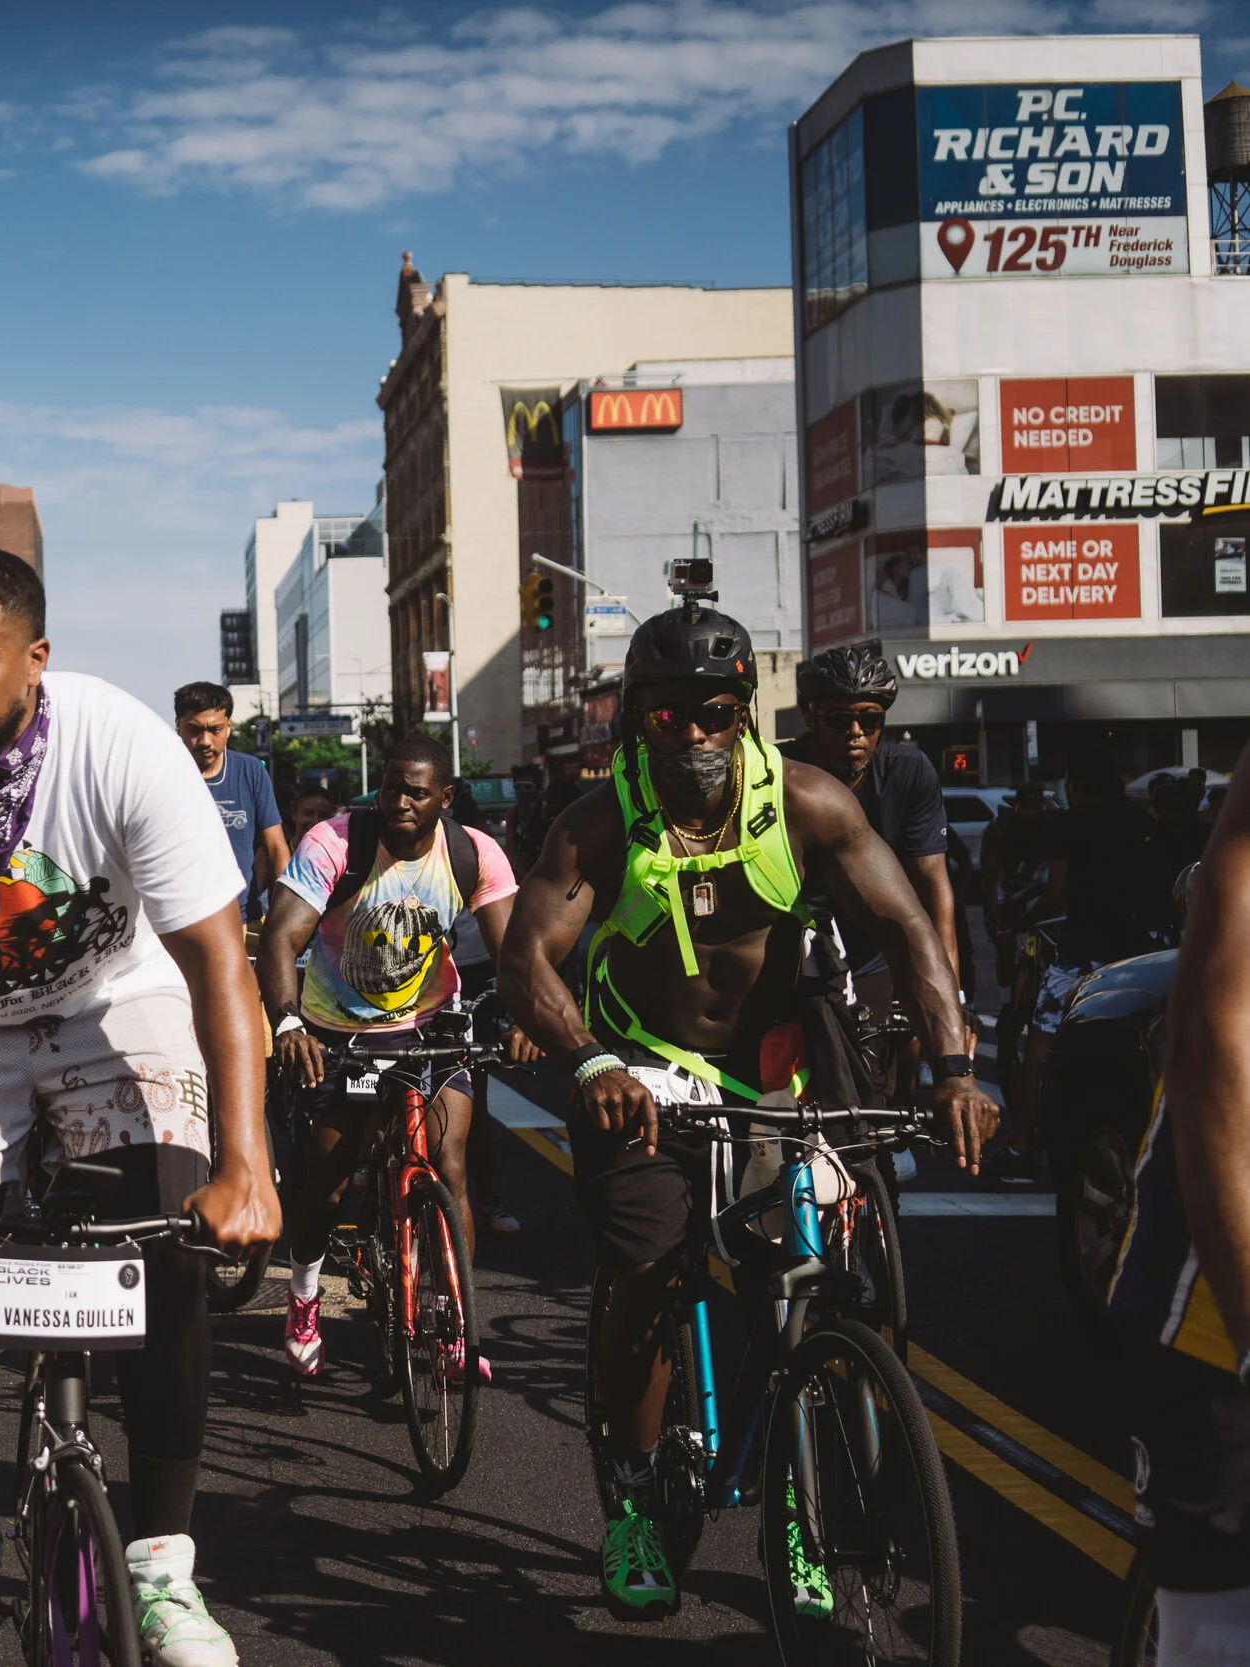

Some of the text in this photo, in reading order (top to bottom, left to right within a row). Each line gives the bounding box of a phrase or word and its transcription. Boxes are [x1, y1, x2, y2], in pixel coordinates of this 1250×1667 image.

[1016, 89, 1087, 122] P.C.
[934, 125, 1170, 161] RICHARD
[979, 161, 1127, 197] & SON
[935, 195, 1172, 214] APPLIANCES ELECTRONICS MATTRESSES
[1109, 224, 1141, 237] Near
[983, 225, 1102, 272] 125TH
[1109, 238, 1174, 252] Frederick
[1110, 254, 1173, 268] Douglass
[1013, 404, 1123, 426] NO CREDIT
[1013, 428, 1094, 448] NEEDED
[1000, 474, 1202, 511] MATTRESS
[1021, 539, 1113, 560] SAME OR
[1021, 561, 1119, 582] NEXT DAY
[1022, 585, 1117, 606] DELIVERY
[896, 647, 1020, 679] verizon
[350, 1079, 376, 1089] RAYSH
[4, 1307, 71, 1328] VANESSA
[76, 1303, 134, 1328] GUILLÉN
